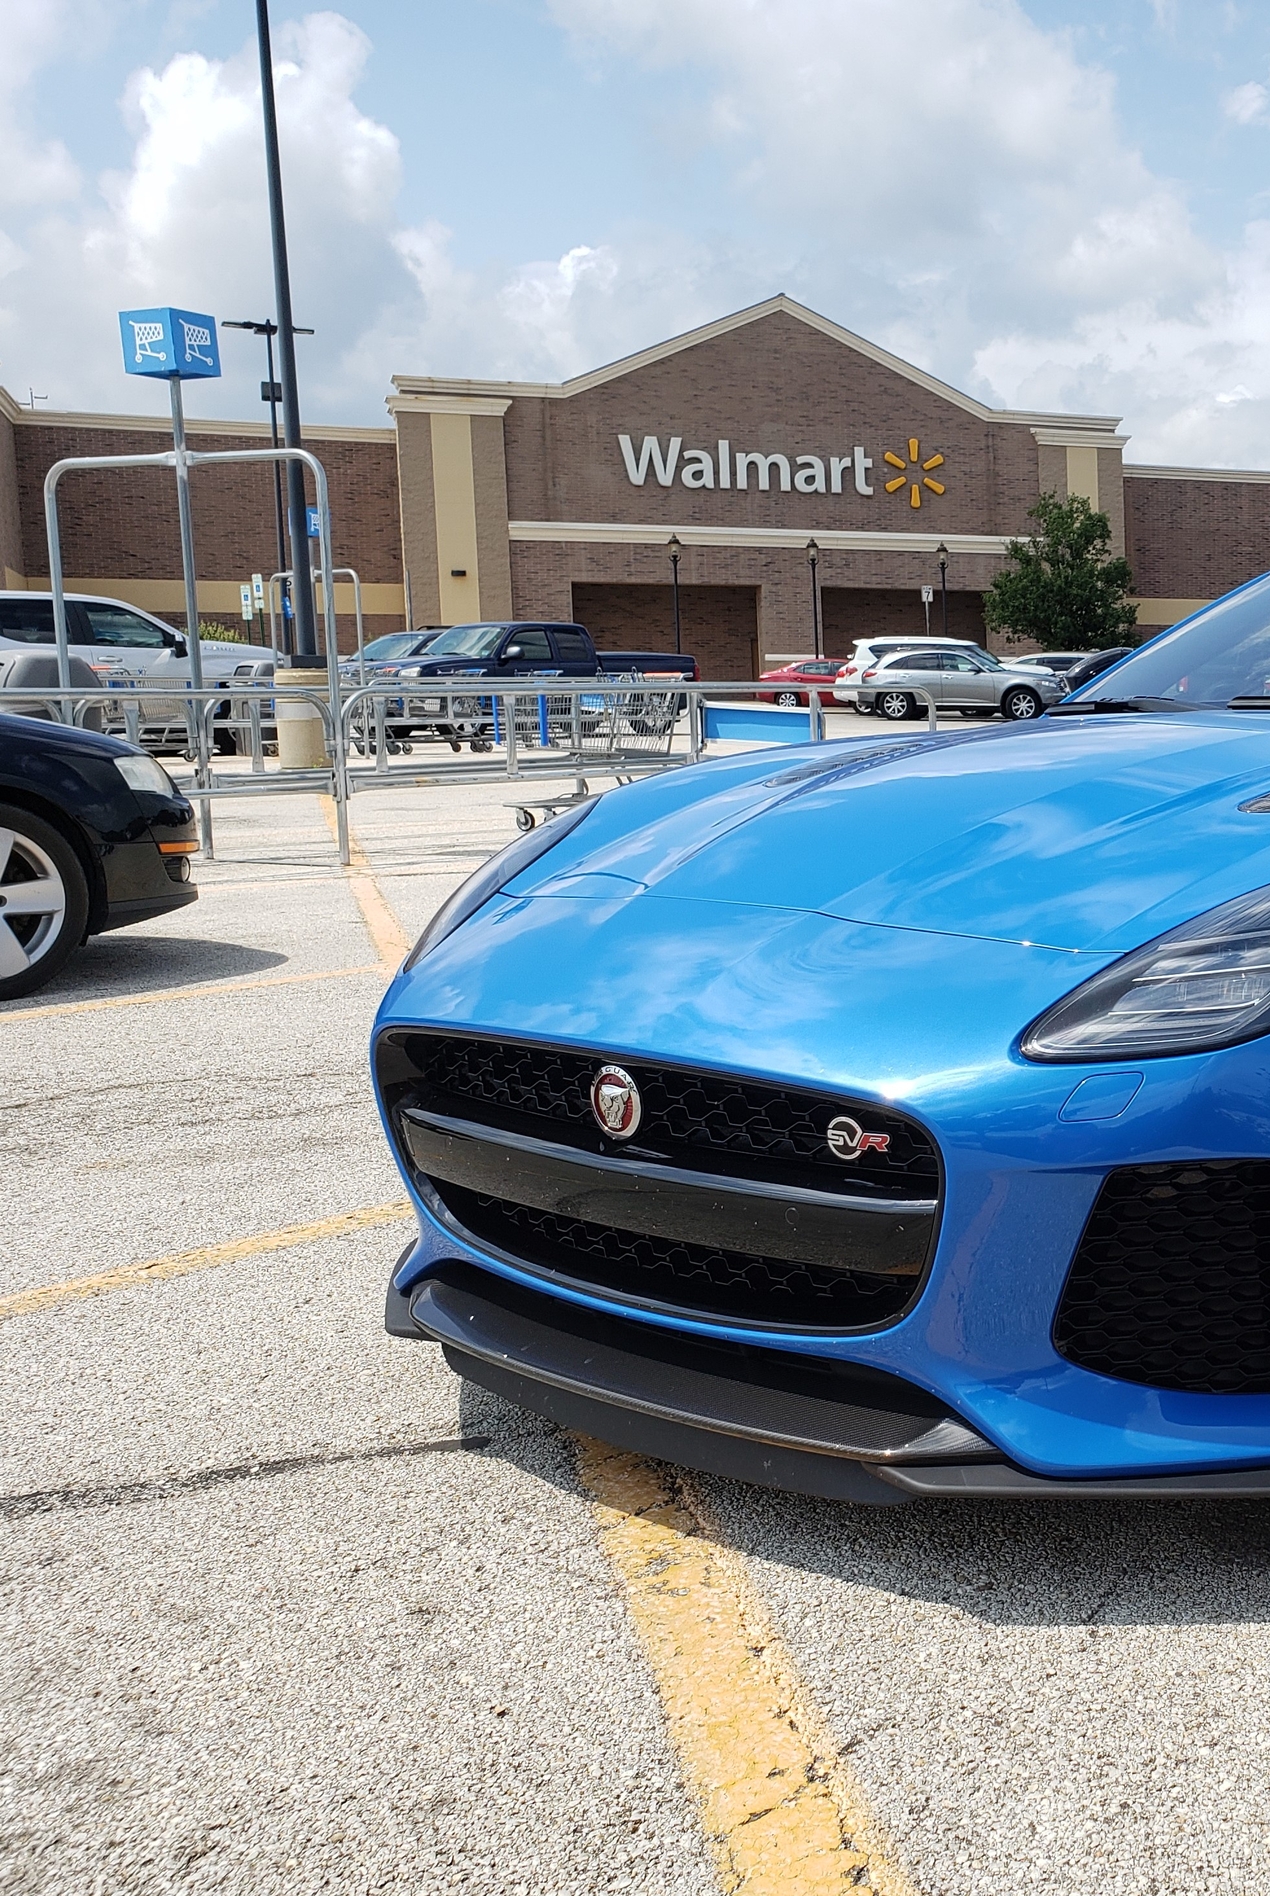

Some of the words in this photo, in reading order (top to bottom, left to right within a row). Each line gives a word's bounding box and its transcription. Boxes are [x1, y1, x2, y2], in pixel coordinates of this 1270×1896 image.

[618, 434, 874, 496] Walmart
[924, 590, 931, 600] 7
[827, 1125, 890, 1154] SVR
